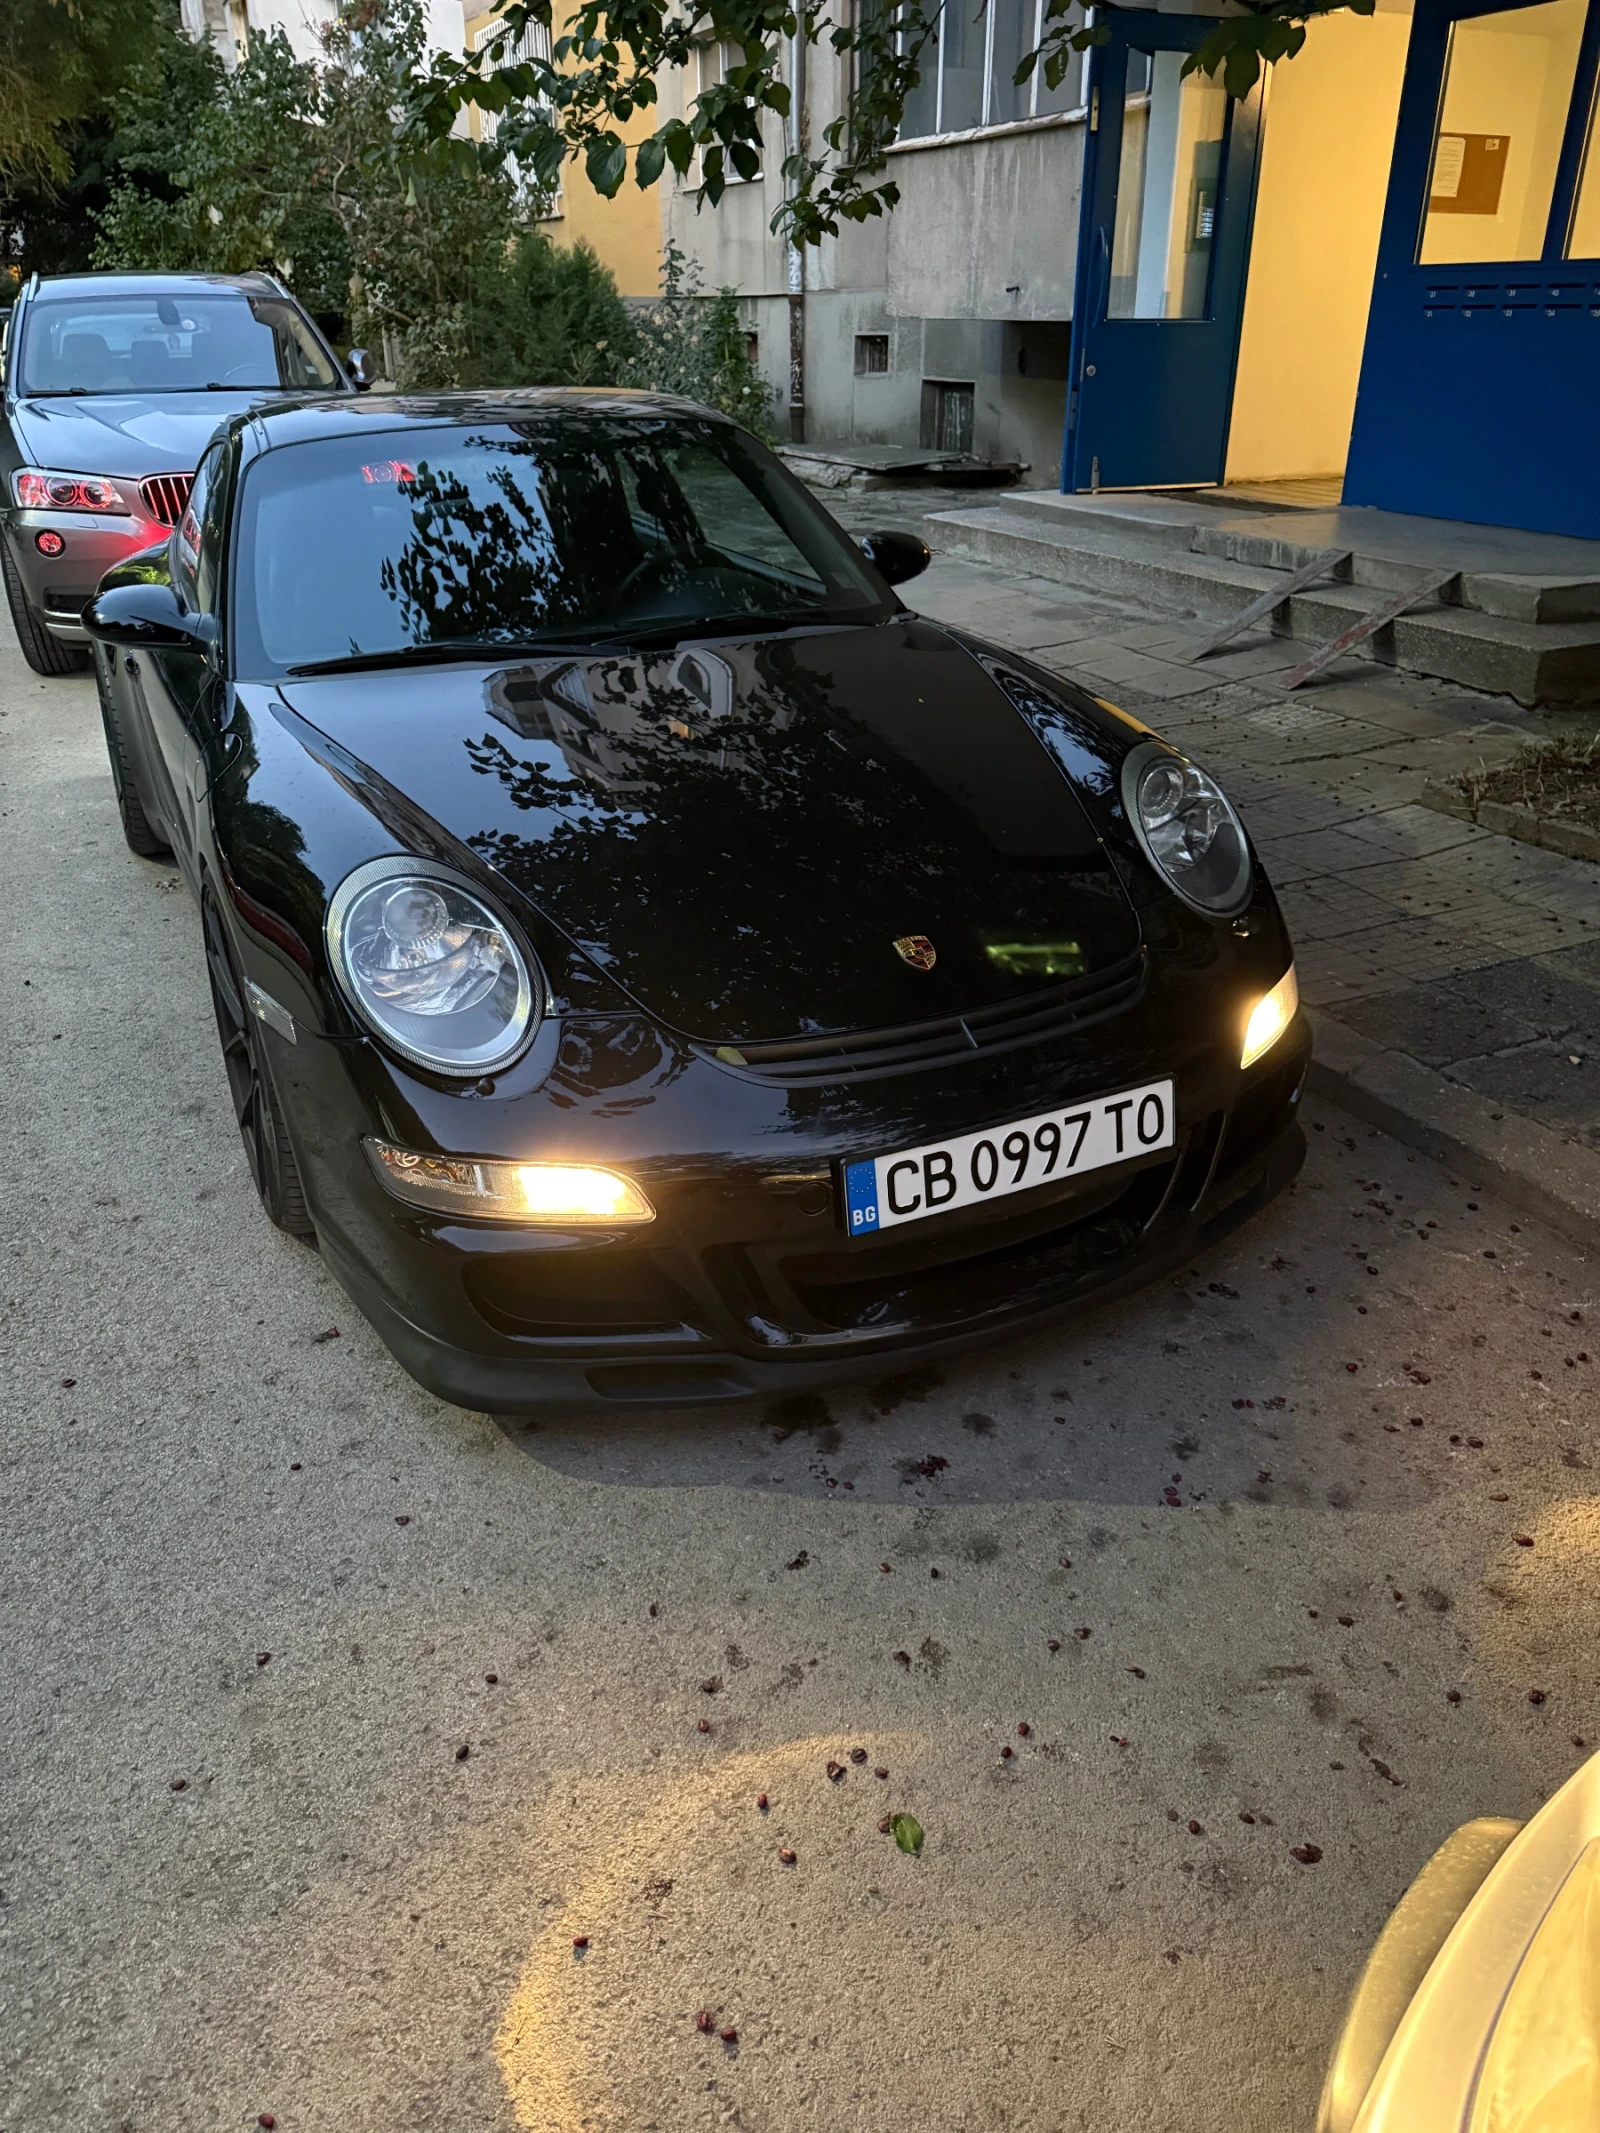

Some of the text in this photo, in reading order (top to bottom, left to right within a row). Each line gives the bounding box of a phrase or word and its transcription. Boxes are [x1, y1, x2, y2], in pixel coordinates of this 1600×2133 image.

[886, 1093, 1165, 1215] CB 0997 TO
[852, 1205, 877, 1226] BG
